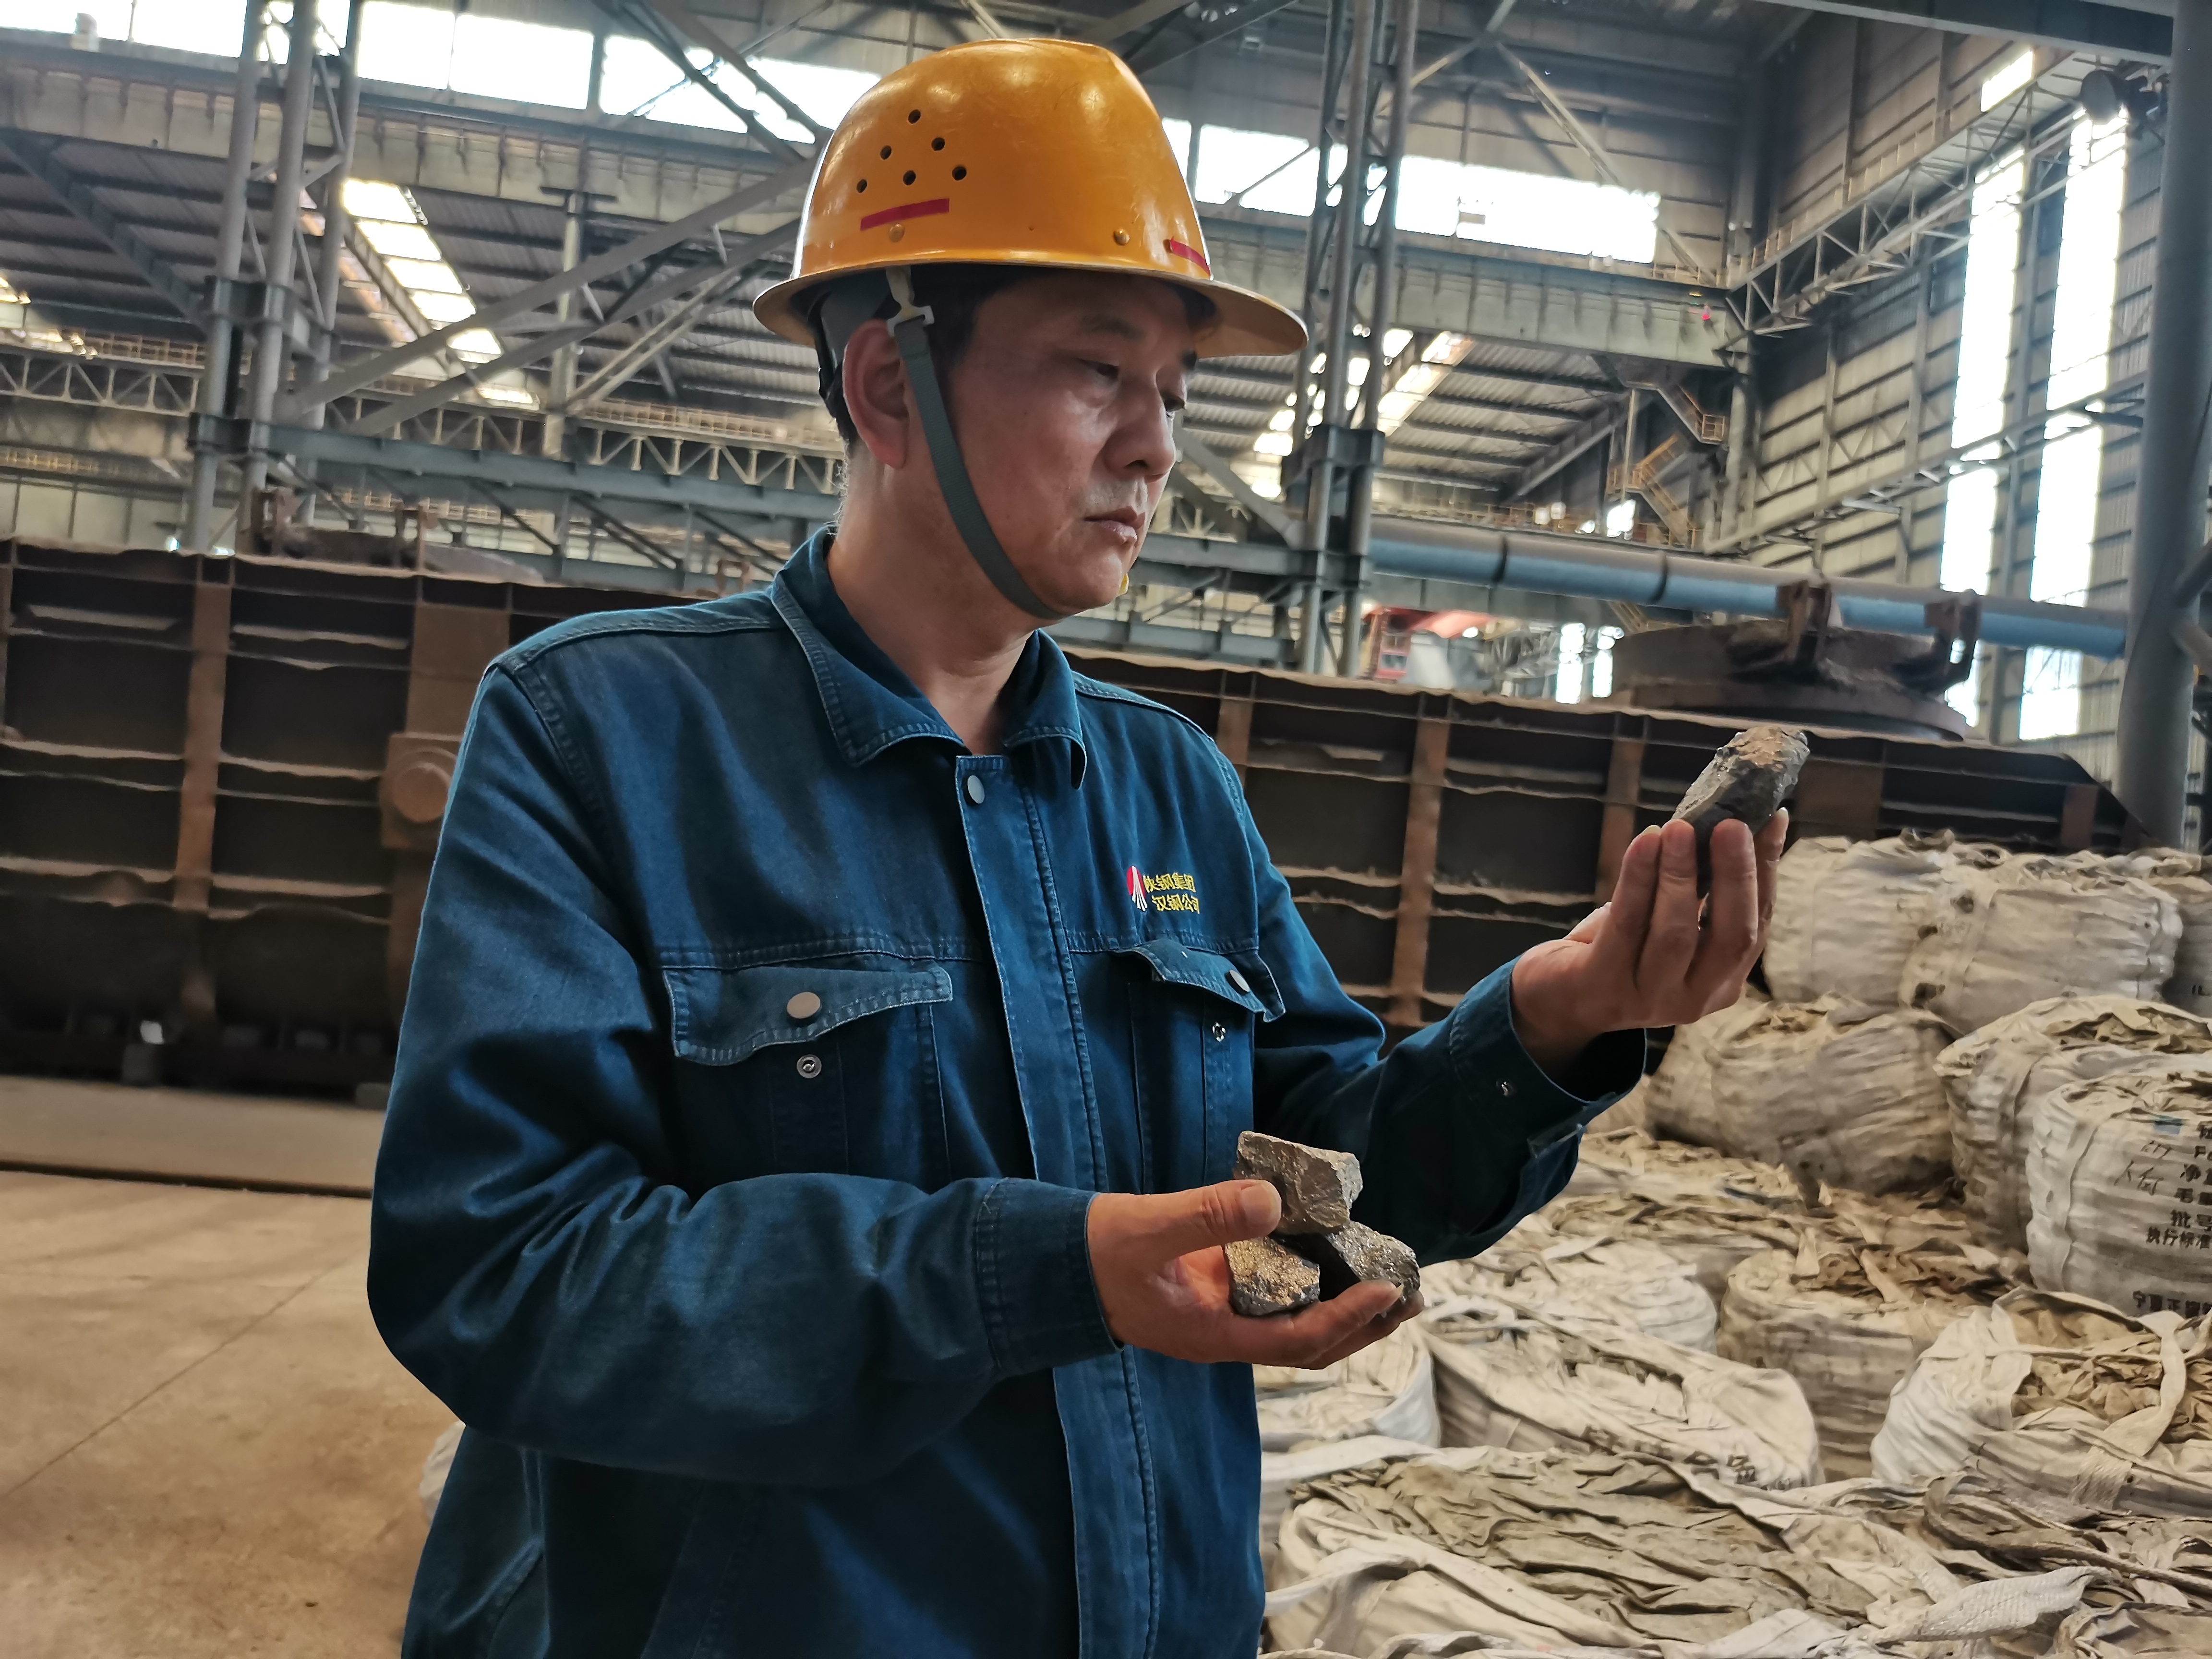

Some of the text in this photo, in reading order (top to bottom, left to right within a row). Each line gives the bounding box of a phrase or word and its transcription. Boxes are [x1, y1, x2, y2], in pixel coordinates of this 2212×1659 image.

[1142, 872, 1196, 893] 陕钢集团
[1152, 893, 1200, 914] 汉钢公司
